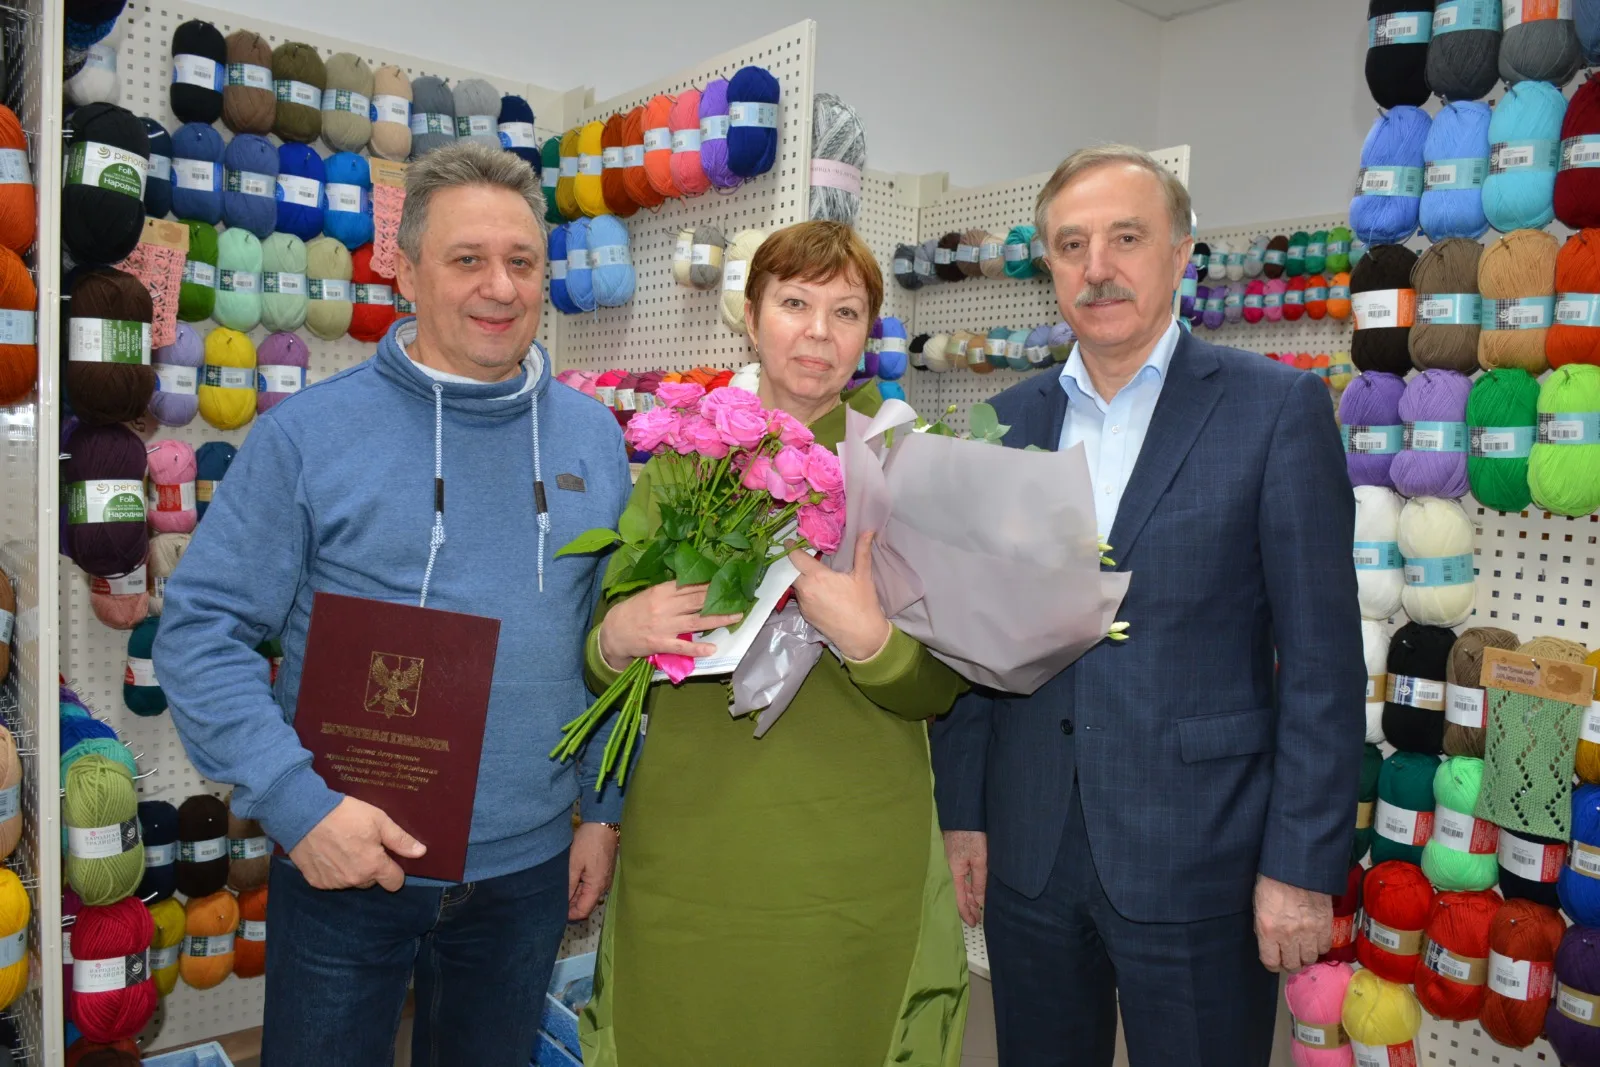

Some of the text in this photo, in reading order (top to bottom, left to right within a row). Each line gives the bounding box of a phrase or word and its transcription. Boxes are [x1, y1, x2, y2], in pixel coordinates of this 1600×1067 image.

[118, 165, 134, 176] Folk
[103, 177, 140, 195] Народная
[108, 511, 144, 519] Народная
[346, 745, 421, 762] Совета депутатов
[324, 752, 439, 775] муниципального образования
